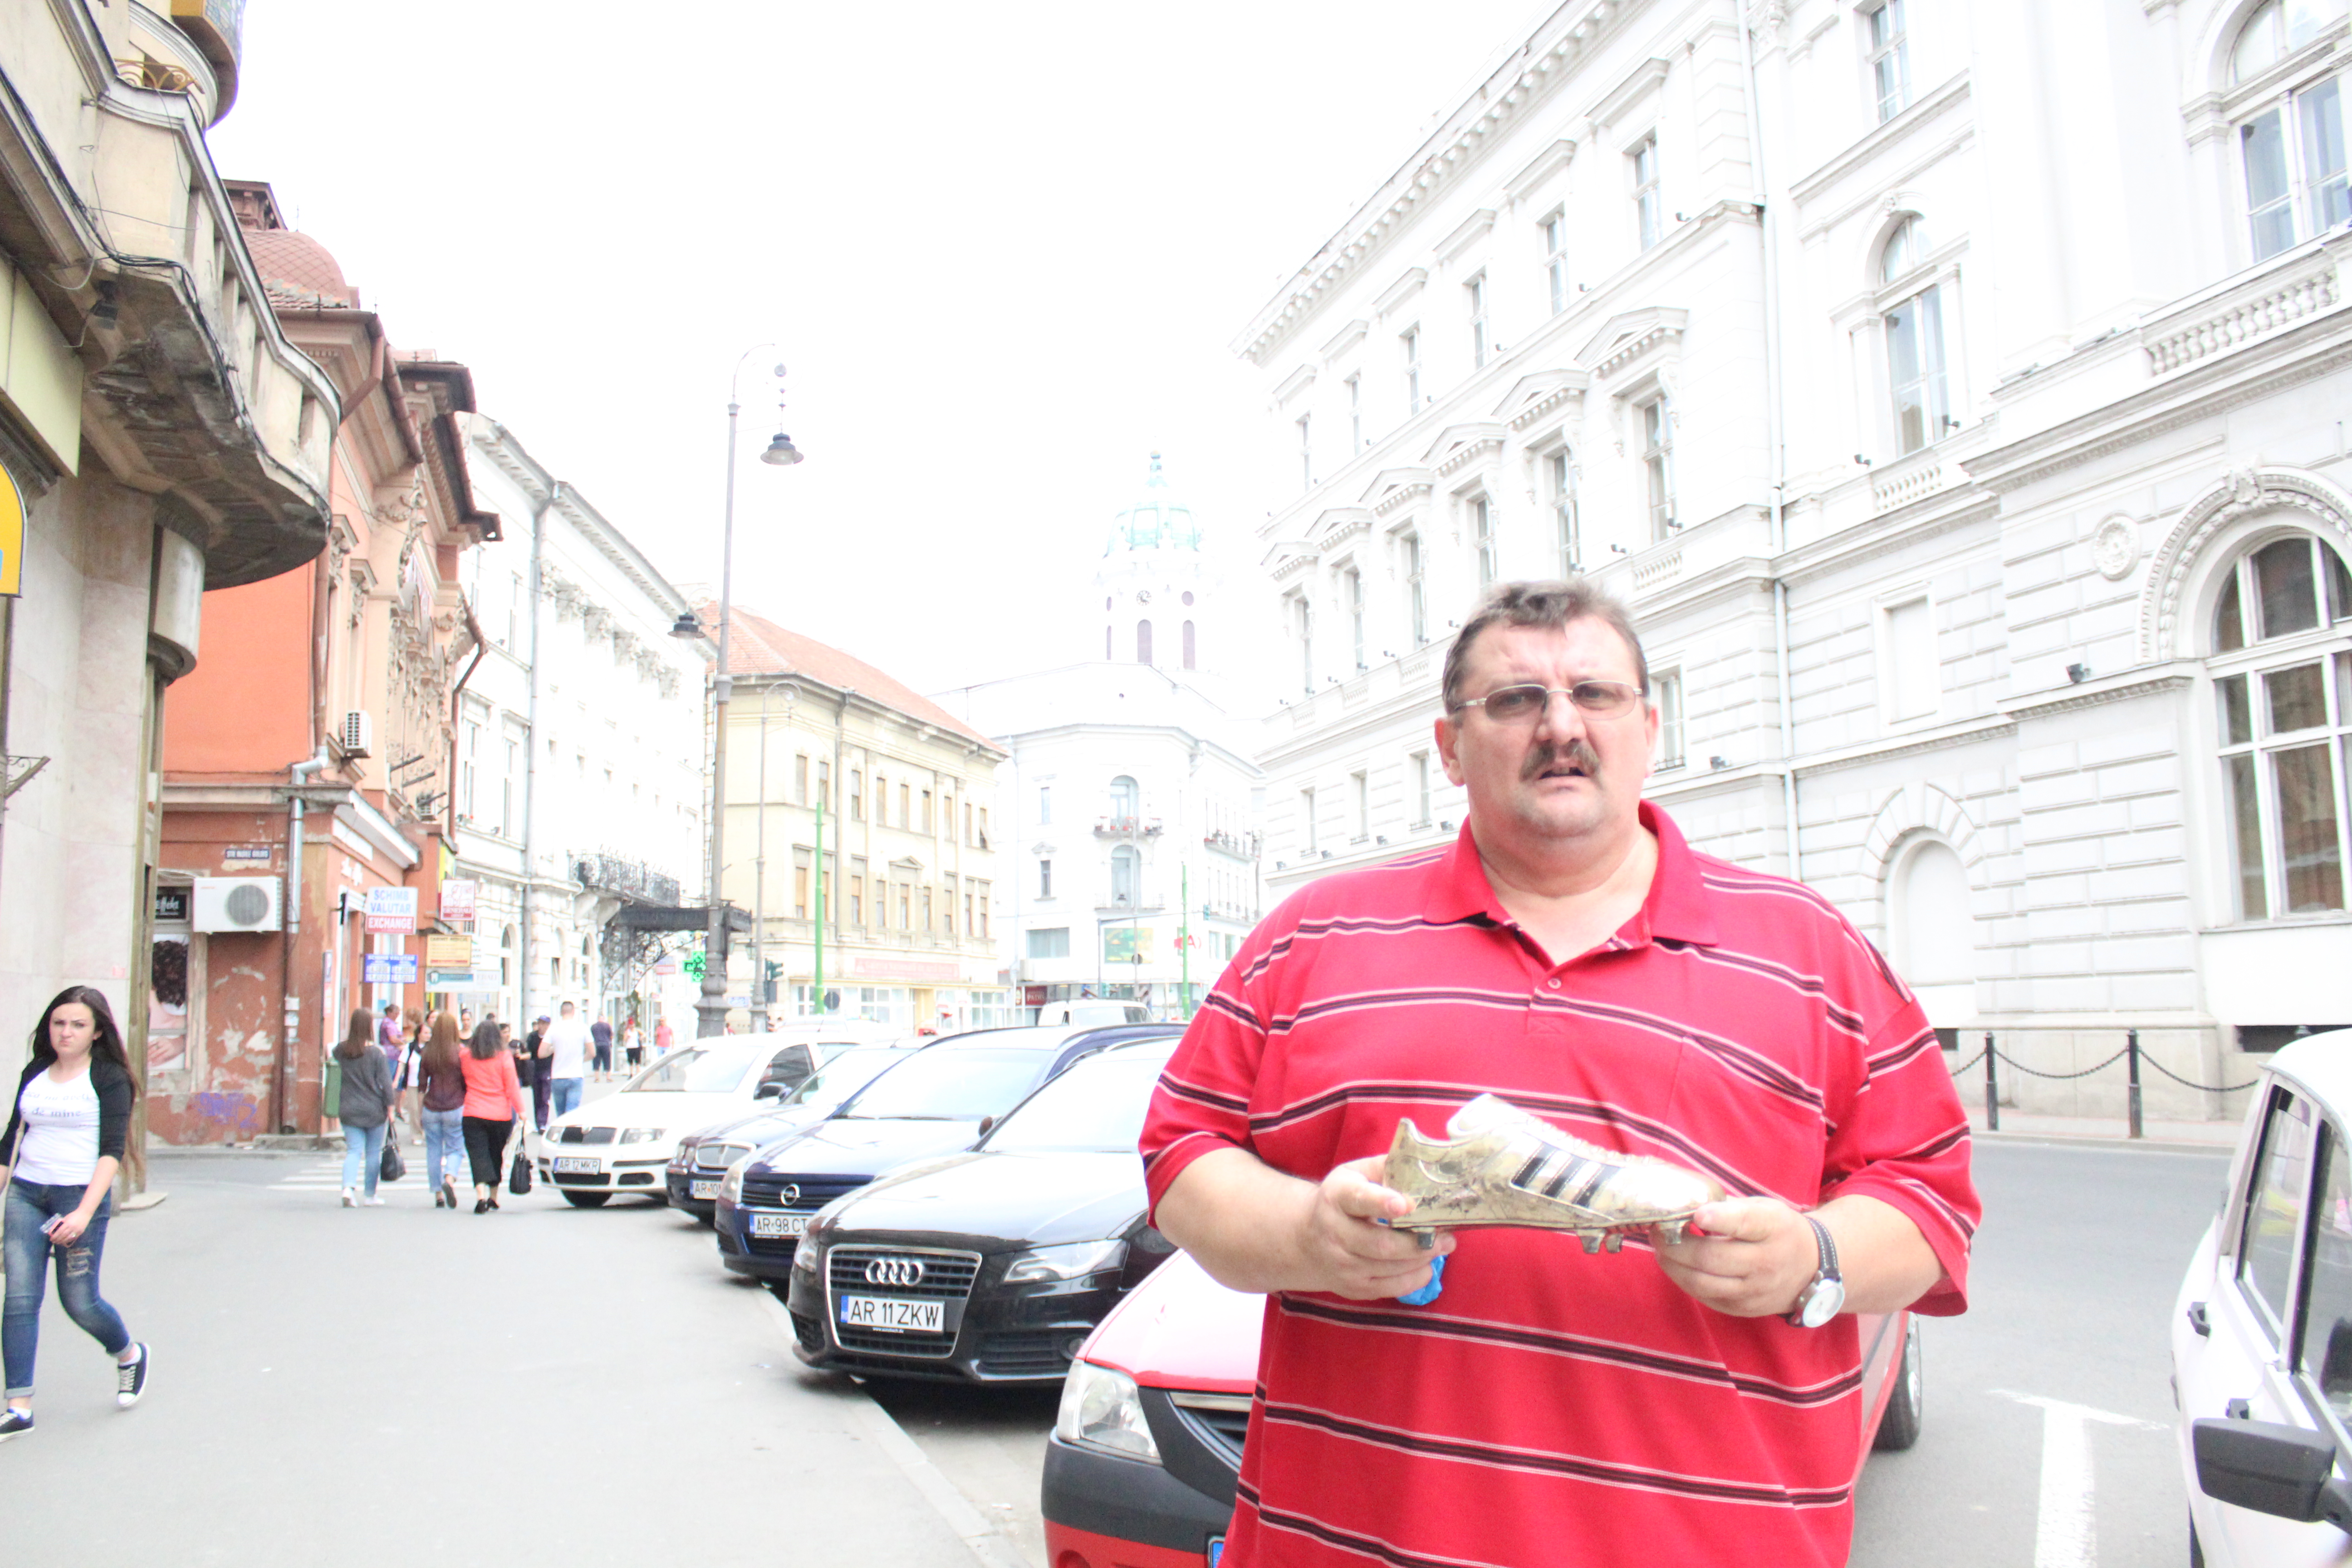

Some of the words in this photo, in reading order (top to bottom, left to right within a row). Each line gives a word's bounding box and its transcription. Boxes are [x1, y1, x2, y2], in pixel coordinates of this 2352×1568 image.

[374, 890, 409, 901] SCHIMB
[370, 903, 411, 914] VALUTAR
[368, 917, 413, 930] EXCHANGE
[559, 1160, 570, 1170] AR
[695, 1182, 706, 1195] AR
[757, 1217, 771, 1232] AR
[850, 1300, 875, 1323] AR
